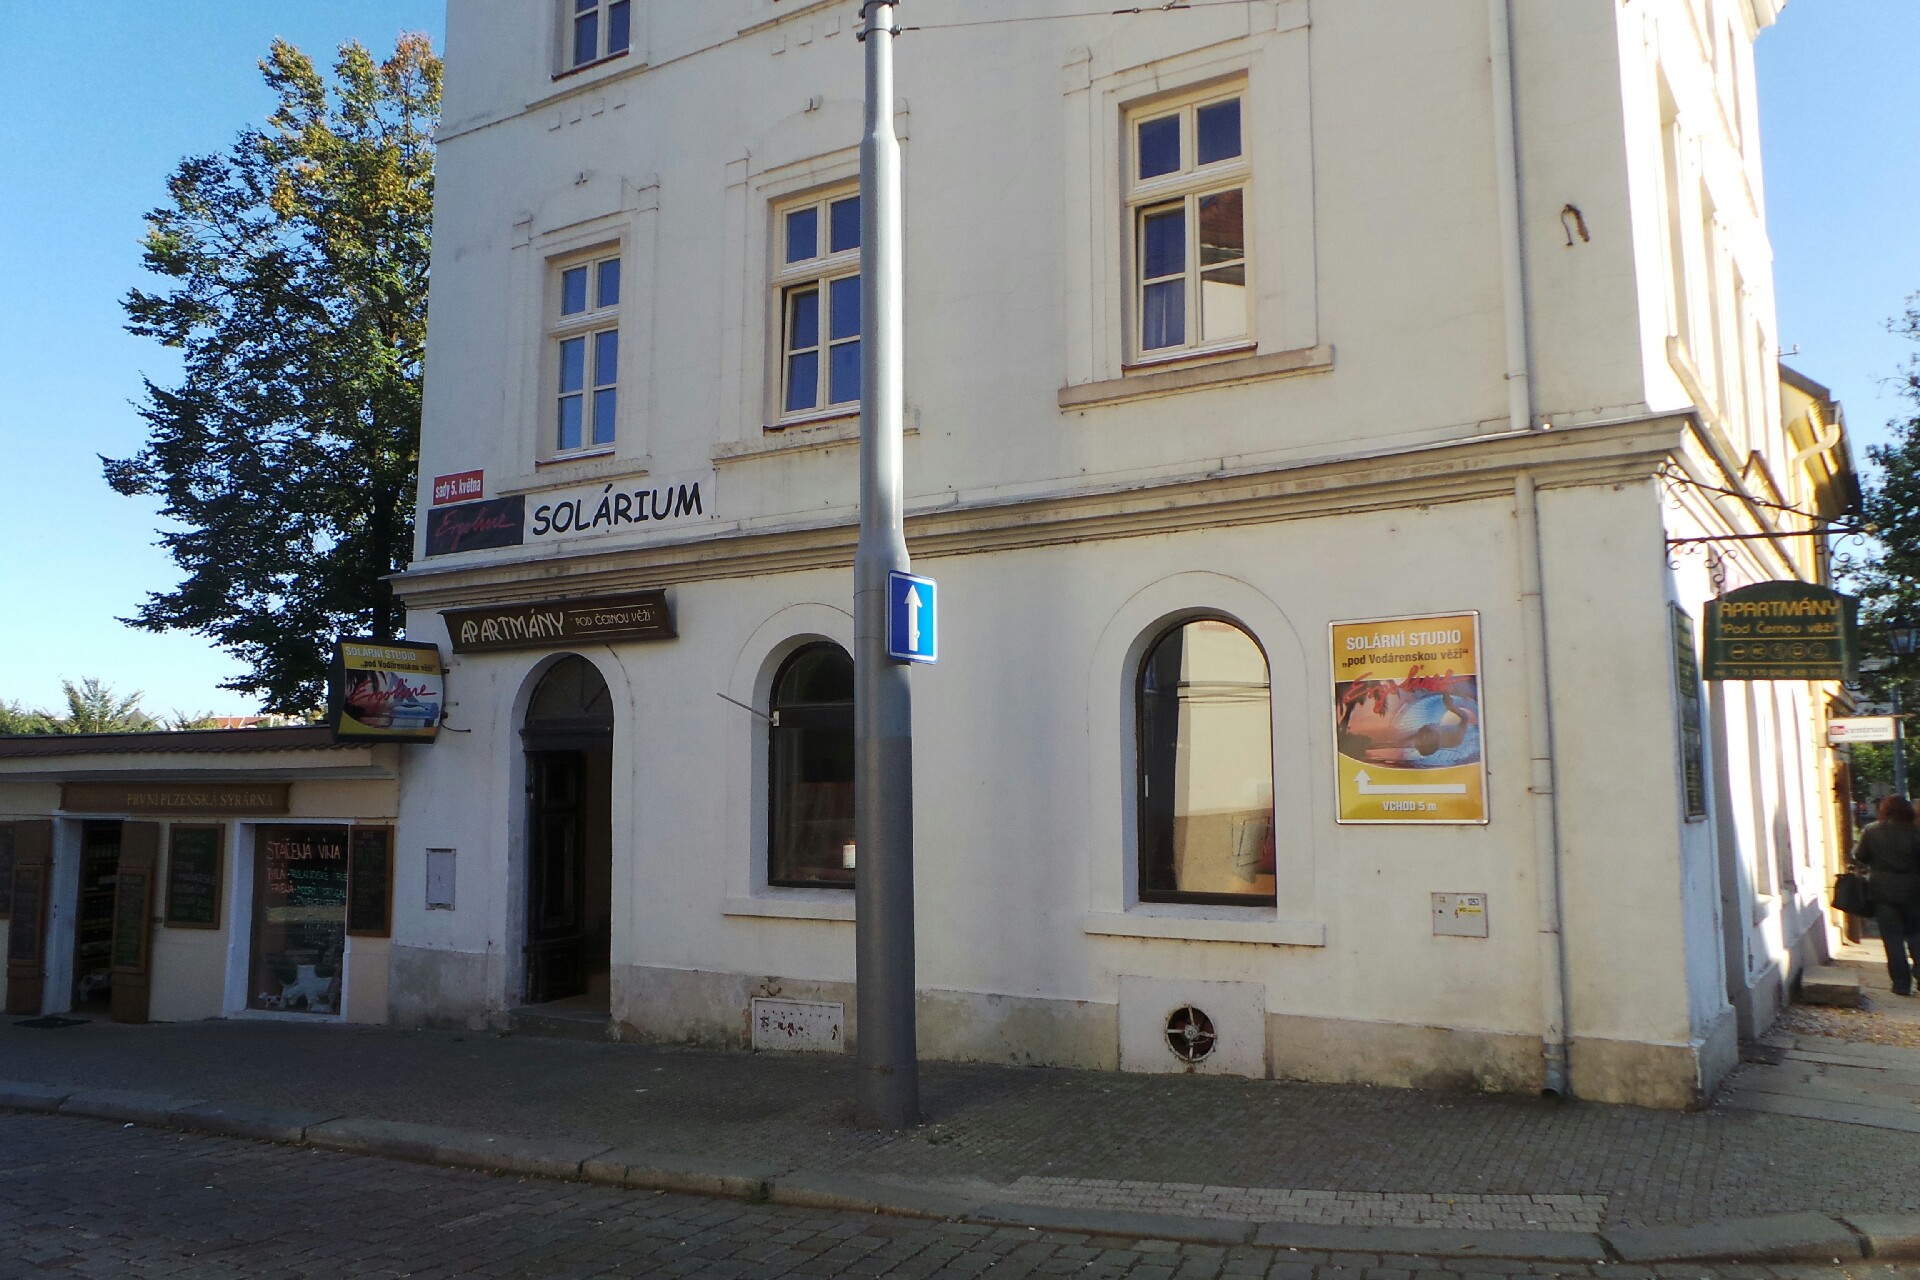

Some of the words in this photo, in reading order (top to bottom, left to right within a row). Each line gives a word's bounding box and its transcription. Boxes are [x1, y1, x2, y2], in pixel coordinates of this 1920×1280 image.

[435, 482, 450, 500] sady
[451, 480, 457, 496] 5.
[459, 477, 481, 494] května
[532, 482, 703, 536] SOLÁRIUM
[1719, 597, 1840, 617] APARTMÁNY
[461, 608, 564, 644] APARTMÁNY
[595, 612, 629, 626] ČERNOU
[1756, 620, 1801, 634] Černou
[1346, 631, 1405, 651] SOLÁRNÍ
[1409, 629, 1461, 646] STUDIO
[345, 646, 383, 657] SOLÁRNÍ
[385, 650, 416, 660] STUDIO
[1368, 650, 1437, 664] Vodárenskou
[347, 677, 437, 706] Ergoline
[1383, 800, 1415, 811] VCHOD
[1418, 801, 1425, 811] 5
[1427, 803, 1437, 811] m
